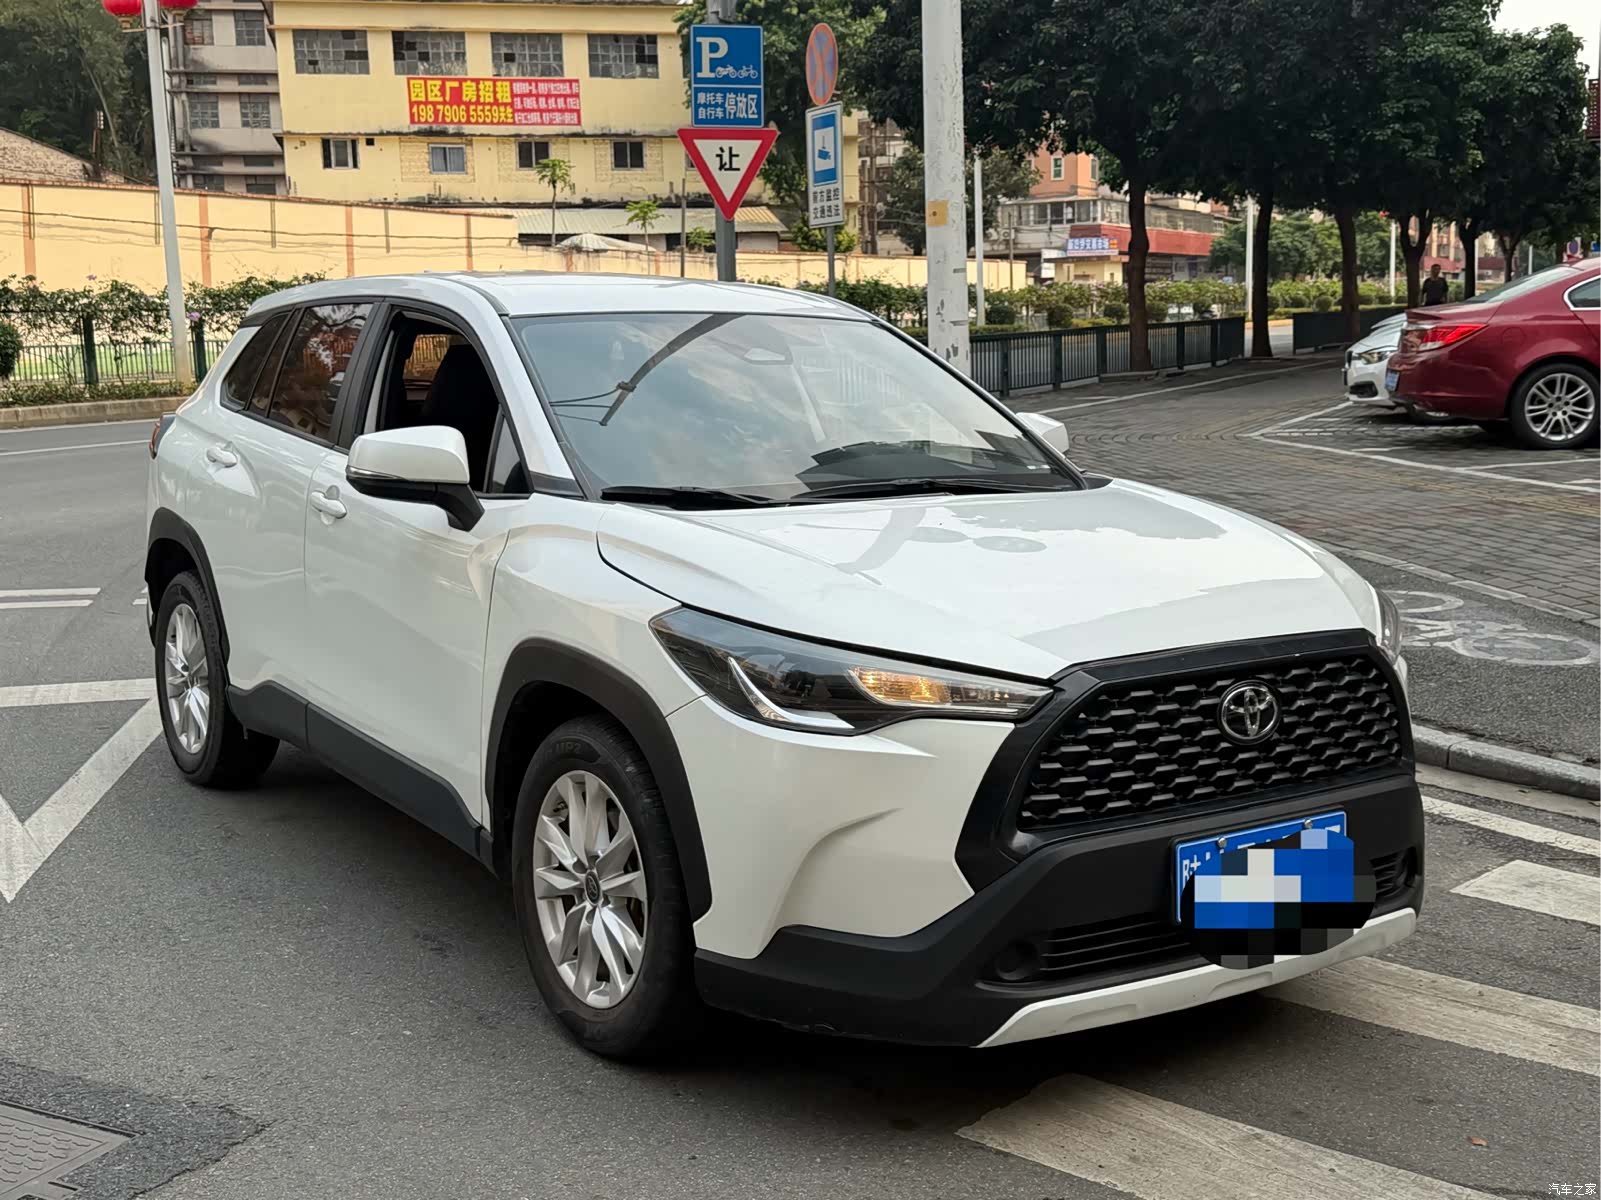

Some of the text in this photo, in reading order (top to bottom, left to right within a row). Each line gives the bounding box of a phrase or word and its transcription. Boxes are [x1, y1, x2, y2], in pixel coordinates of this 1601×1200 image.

[695, 37, 729, 78] P
[409, 79, 512, 103] 园区厂房招租
[697, 92, 724, 105] 摩托车
[411, 104, 435, 122] 198
[436, 105, 467, 123] 7906
[697, 107, 724, 119] 自行车
[725, 92, 759, 119] 停放区
[715, 146, 741, 172] 让
